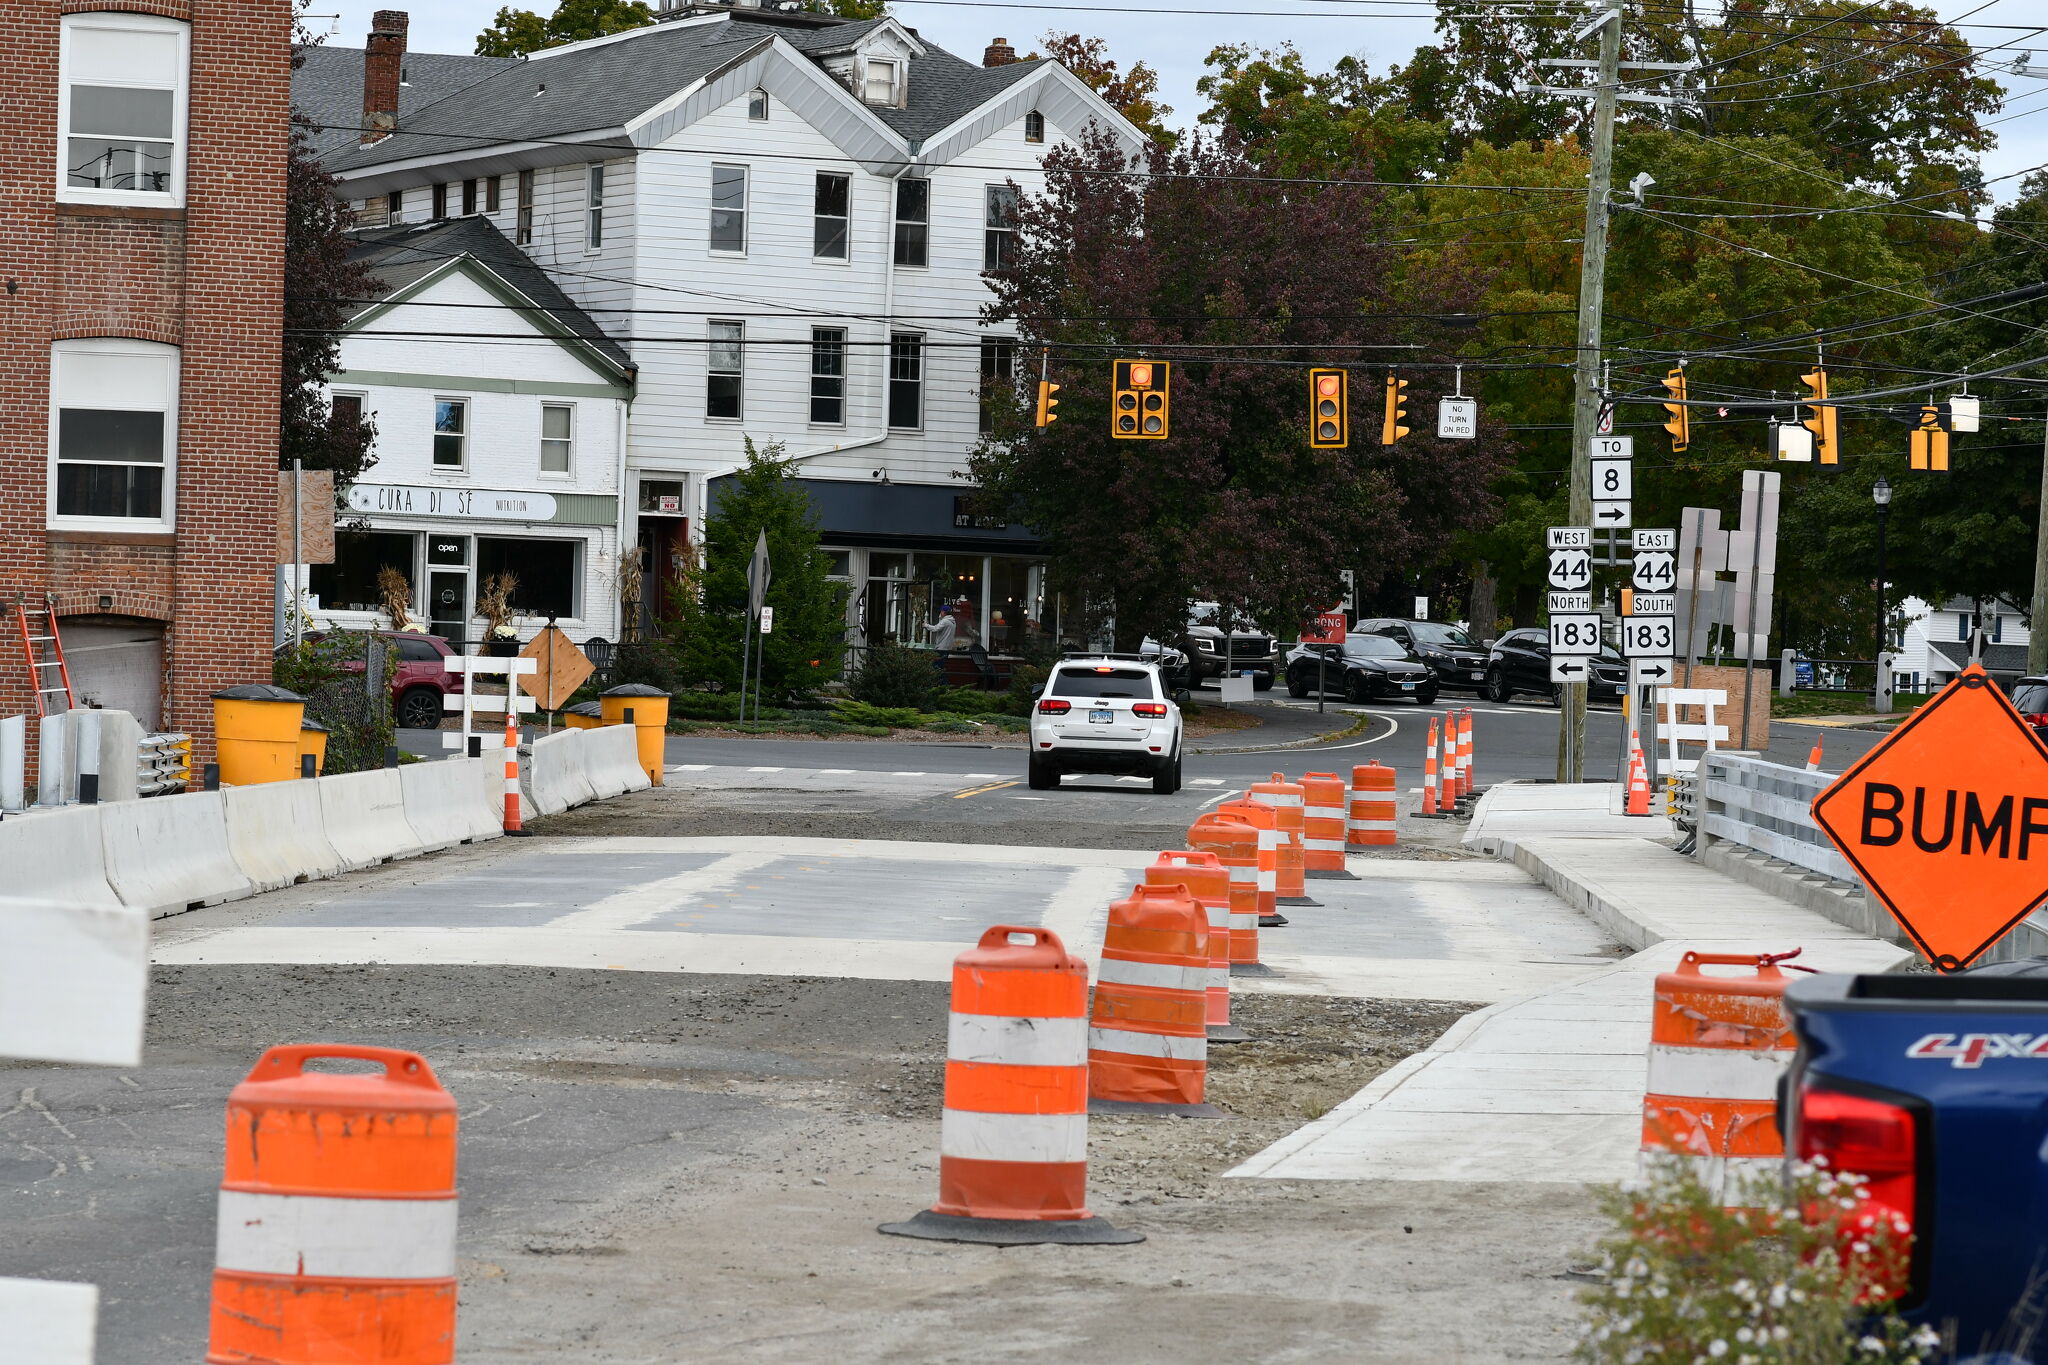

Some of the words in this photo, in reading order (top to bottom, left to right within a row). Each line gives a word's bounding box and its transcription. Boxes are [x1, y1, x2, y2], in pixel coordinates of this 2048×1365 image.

[1452, 405, 1463, 413] NO
[1448, 415, 1467, 423] TURN
[1455, 426, 1470, 434] RED
[1601, 441, 1621, 453] TO
[1604, 468, 1619, 491] 8
[378, 487, 413, 511] CURA
[430, 490, 442, 513] DI
[495, 499, 527, 512] NUTRITION
[955, 514, 970, 526] AT
[1553, 531, 1586, 544] WEST
[1638, 533, 1669, 547] EAST
[438, 544, 458, 553] open
[1552, 559, 1587, 581] 44
[1637, 561, 1671, 583] 44
[1551, 595, 1589, 609] NORTH
[1635, 597, 1673, 611] SOUTH
[1306, 617, 1341, 628] RONG
[1553, 623, 1597, 645] 183
[1626, 625, 1671, 648] 183
